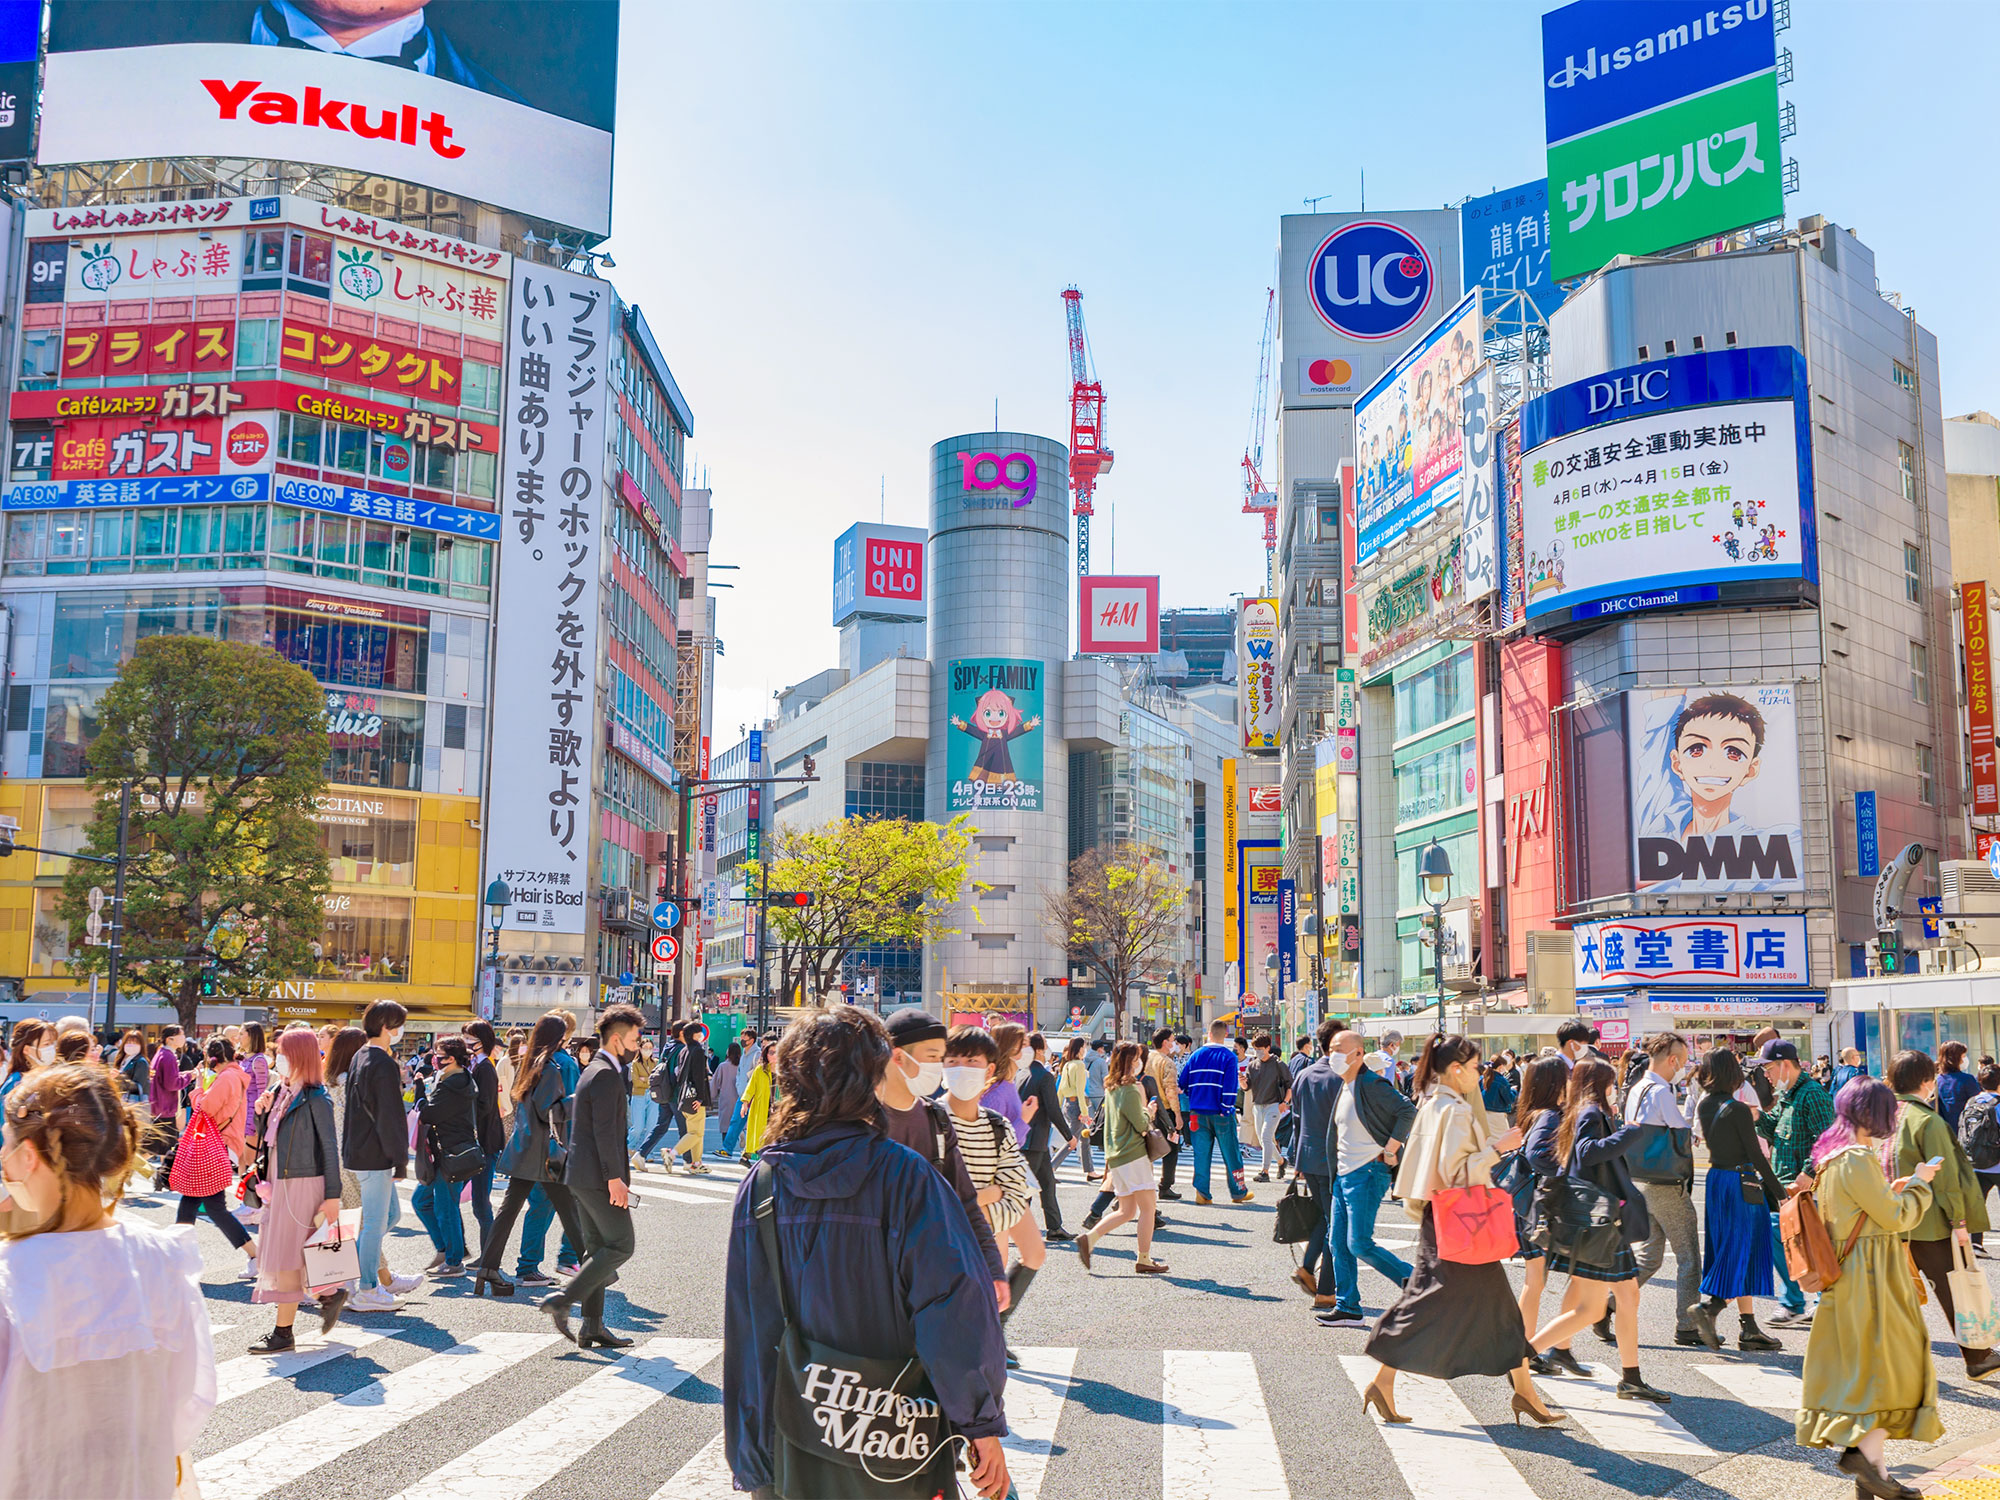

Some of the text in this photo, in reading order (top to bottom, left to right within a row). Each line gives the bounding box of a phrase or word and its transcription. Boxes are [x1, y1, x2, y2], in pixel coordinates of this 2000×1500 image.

[200, 79, 466, 160] Yakult
[1562, 122, 1764, 233] サロンパス
[53, 201, 232, 230] しゃぶしゃぶバイキング
[252, 201, 277, 215] 寿司
[321, 207, 502, 269] しゃぶしゃぶバイキング
[32, 260, 64, 282] 9F
[129, 242, 230, 280] しゃぶ葉
[1325, 252, 1421, 306] UC
[394, 267, 497, 321] しゃぶ葉
[67, 327, 231, 368] プライス
[283, 326, 455, 391] コンタクト
[161, 384, 244, 418] ガスト
[1587, 369, 1670, 415] DHC
[403, 411, 482, 452] ガスト
[512, 276, 554, 561] いい曲あります。
[15, 441, 53, 467] 7F
[62, 438, 106, 459] Café
[62, 459, 105, 471] レストラン
[109, 430, 212, 475] ガスト
[231, 440, 265, 454] ガスト
[1532, 422, 1766, 488] 春の交通安全運動実施中
[10, 480, 257, 505] AEON 英会話イーオン 6F
[957, 452, 1037, 507] 109
[1463, 377, 1492, 588] もんじゃ
[284, 482, 496, 534] AEON 英会話イーオン
[1554, 484, 1732, 534] 世界一の交通安全都市
[1572, 512, 1705, 550] TOKYOを目指して
[549, 290, 600, 862] ブラジャーのホックを外す歌より、
[872, 546, 912, 569] UNI
[871, 569, 916, 594] QLO
[1100, 601, 1139, 627] H&M
[1600, 592, 1679, 614] DHC Channel
[1966, 588, 1998, 805] クスリのことなら 三千里
[320, 815, 367, 825] PROVENCE
[1002, 798, 1018, 807] ON
[1020, 798, 1037, 808] AIR
[1227, 820, 1235, 873] Matsumoto
[1860, 796, 1877, 873] 大盛堂商事ビル
[504, 869, 571, 886] サブスク解禁
[1638, 834, 1798, 881] DMM
[514, 887, 583, 906] Hair is Bad
[1257, 868, 1281, 890] 薬
[1283, 889, 1292, 925] MIZUHO
[1582, 928, 1786, 974] 大盛堂書店
[1745, 972, 1798, 980] BOOKS TAISEIDO
[801, 1363, 939, 1427] Human
[813, 1406, 930, 1460] Made
